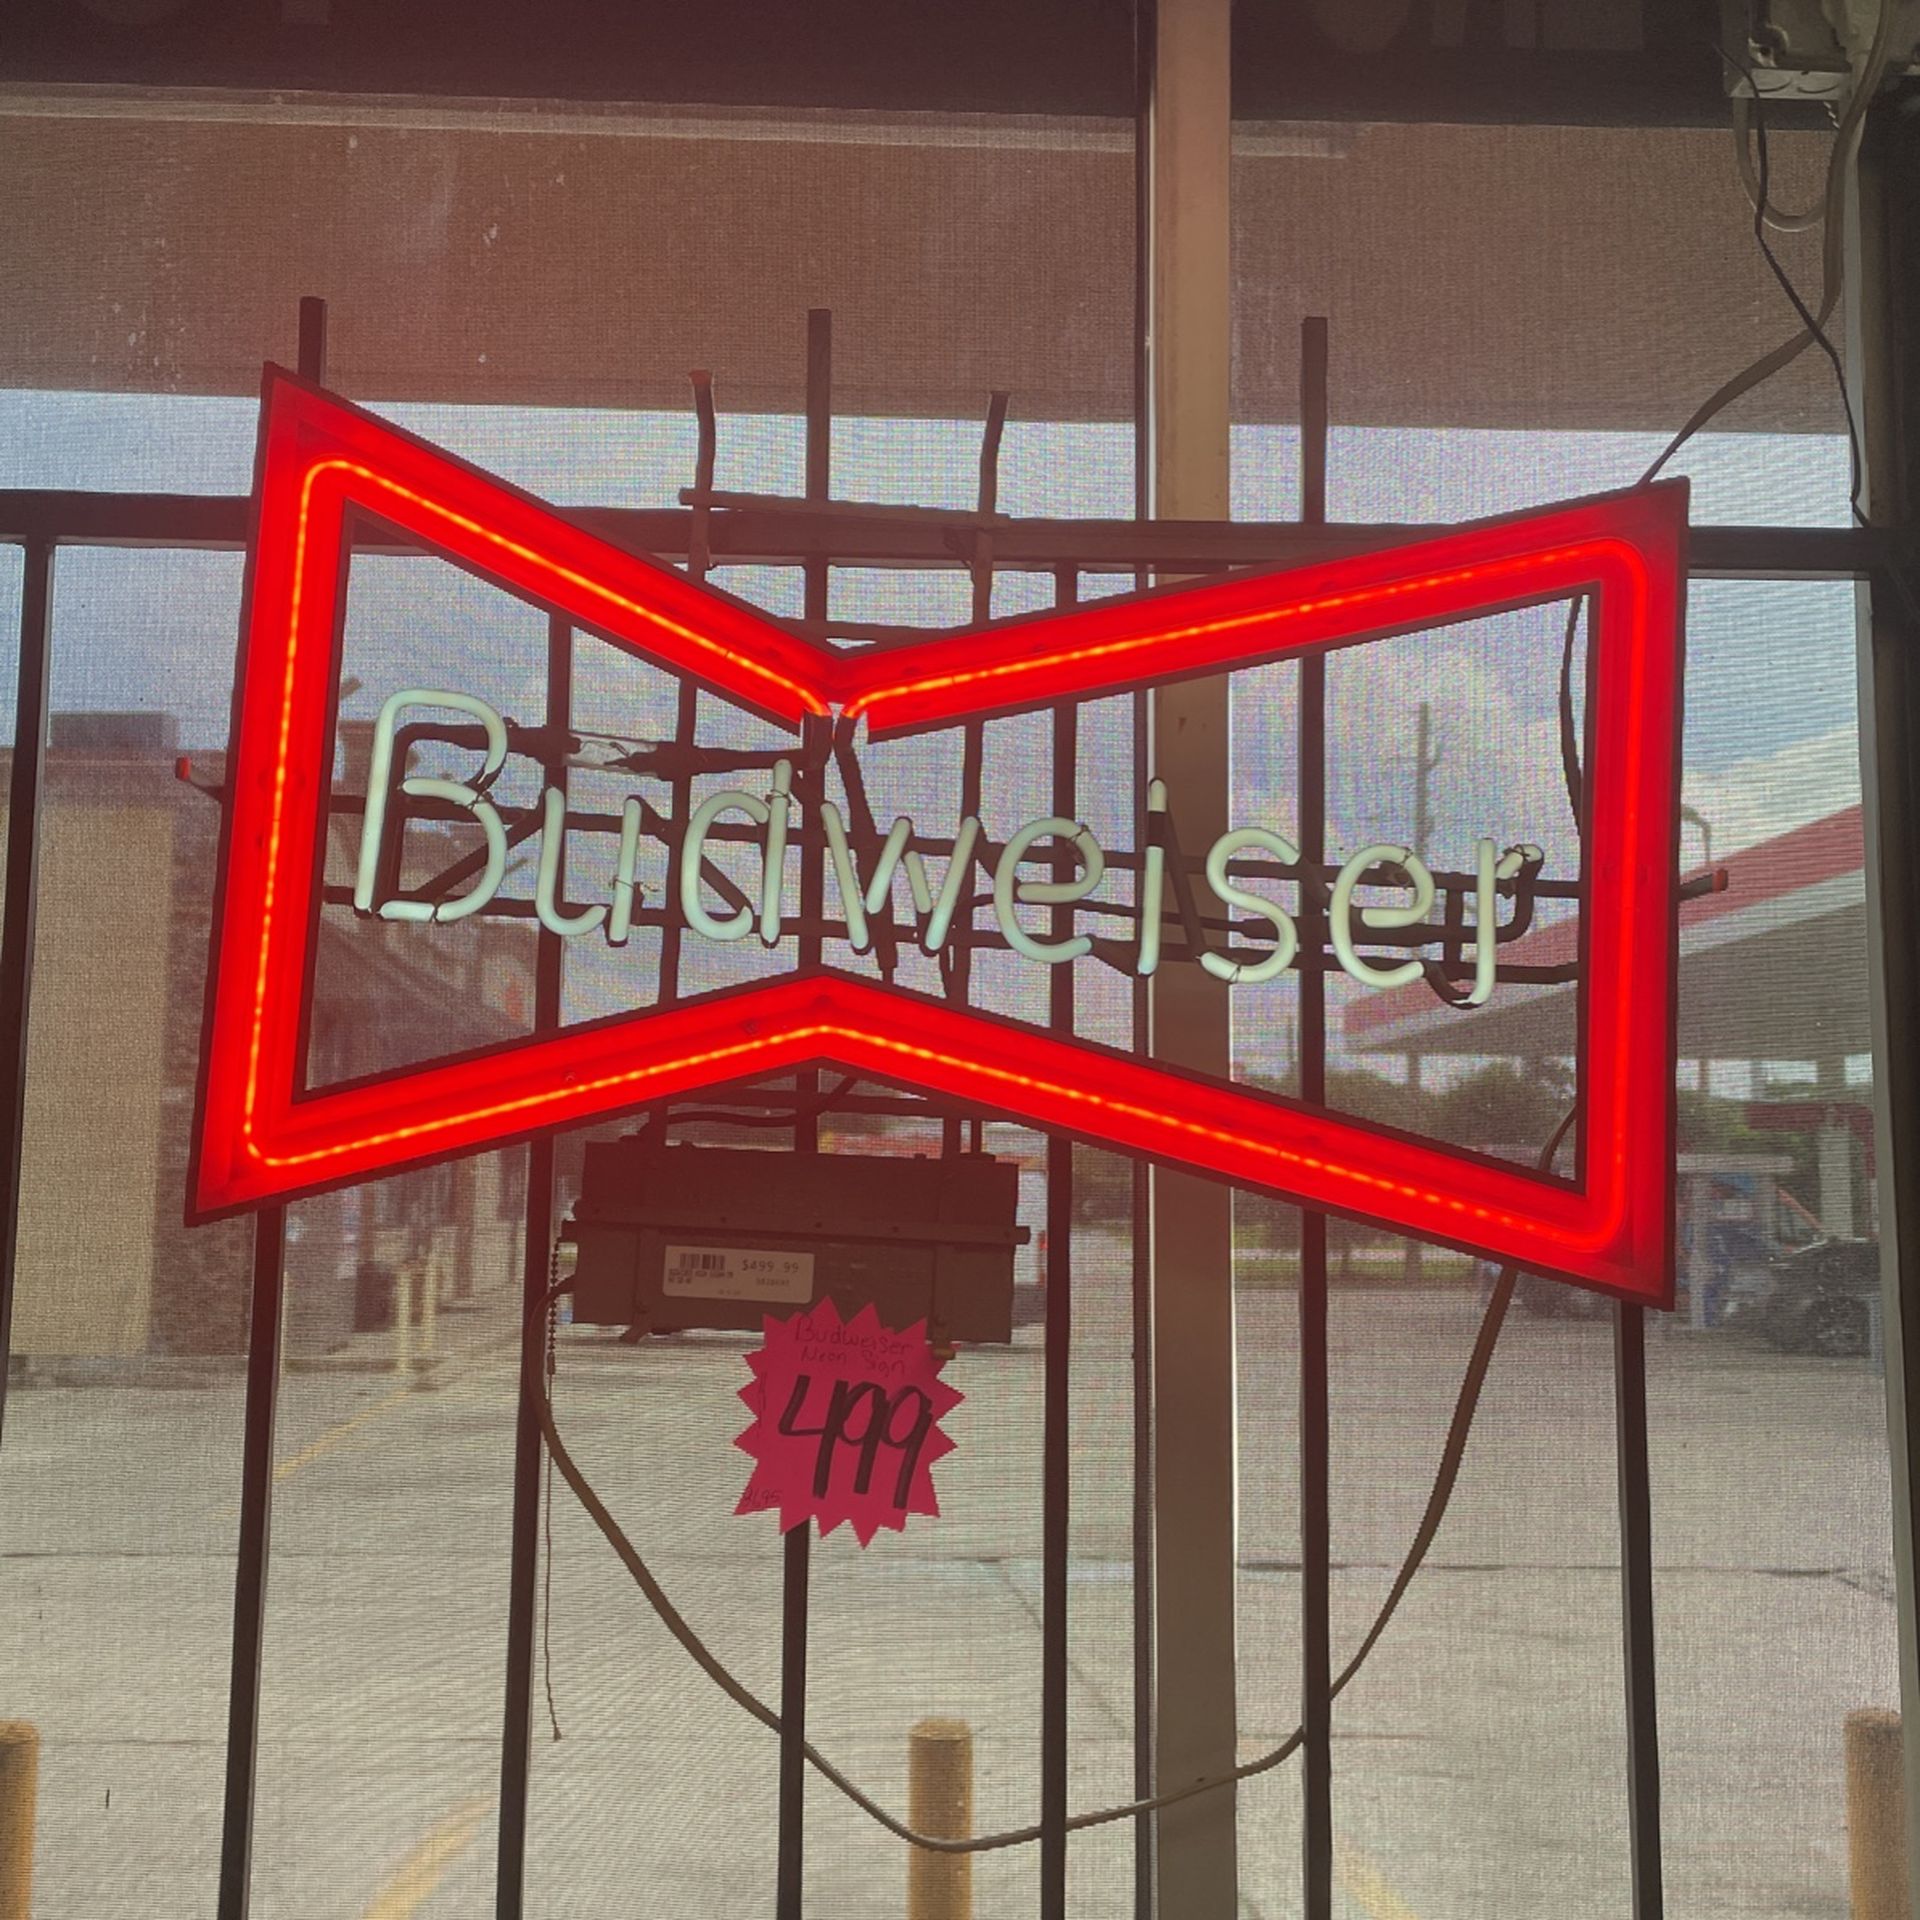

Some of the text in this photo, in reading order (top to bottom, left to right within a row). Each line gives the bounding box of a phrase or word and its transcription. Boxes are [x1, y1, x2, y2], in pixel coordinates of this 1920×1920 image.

[353, 688, 1546, 1008] Budweiser
[741, 1258, 800, 1274] $49999
[795, 1313, 914, 1355] Budweiser
[801, 1345, 905, 1377] Neon Sign
[778, 1374, 933, 1510] 499
